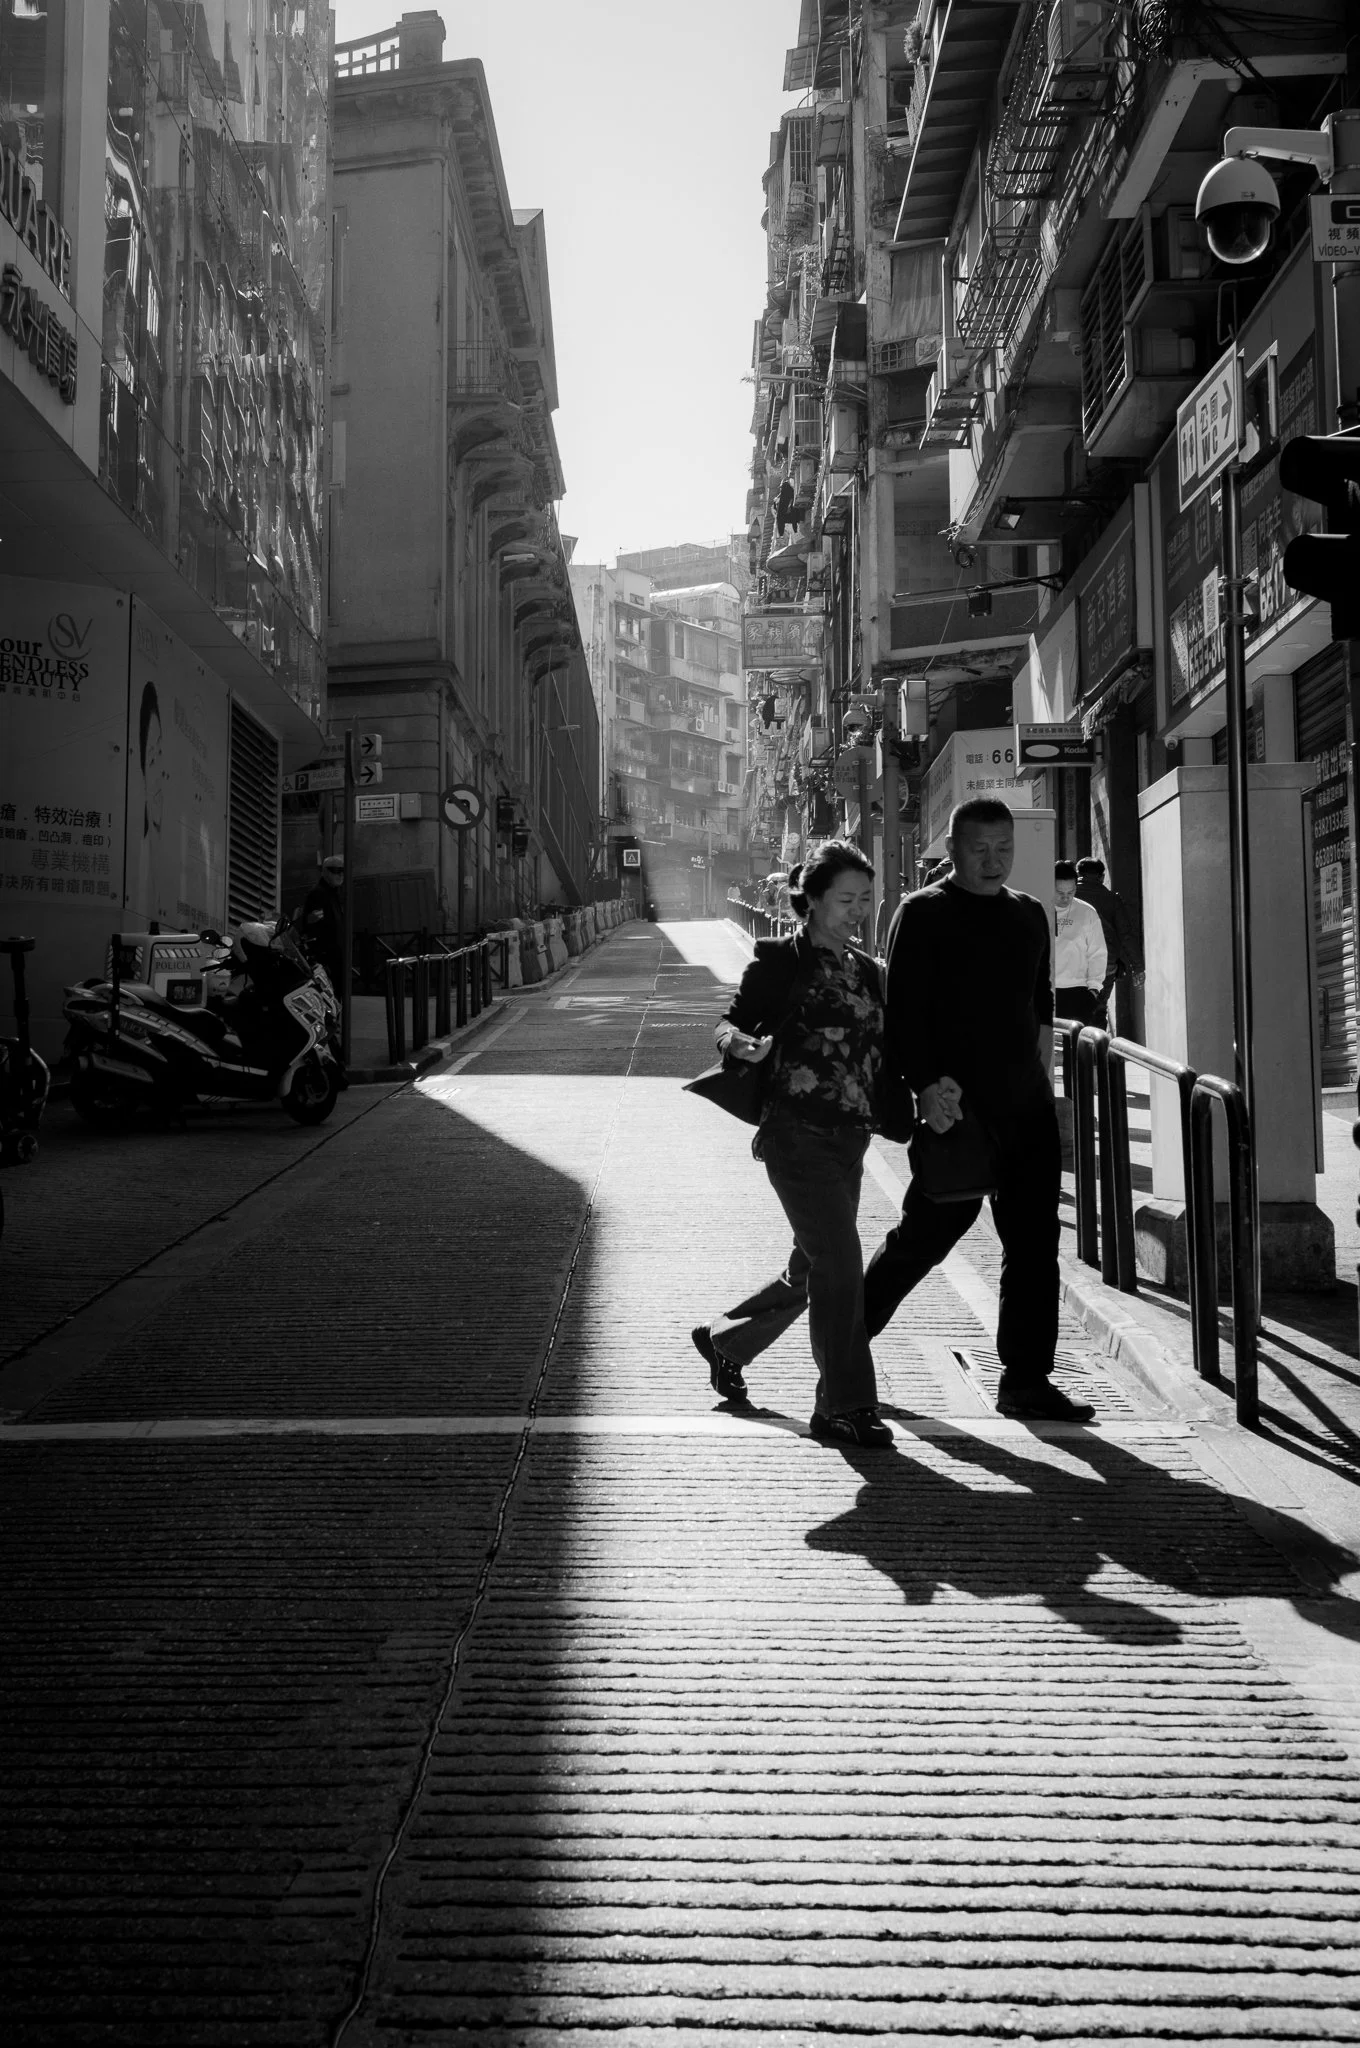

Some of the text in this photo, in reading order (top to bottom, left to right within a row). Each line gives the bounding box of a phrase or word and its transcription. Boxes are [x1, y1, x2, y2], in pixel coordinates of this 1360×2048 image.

[1201, 424, 1218, 467] WC
[0, 653, 89, 678] ENDLESS
[0, 667, 81, 691] BEAUTY
[1063, 746, 1088, 754] Kodak
[32, 849, 110, 874] 專業機構
